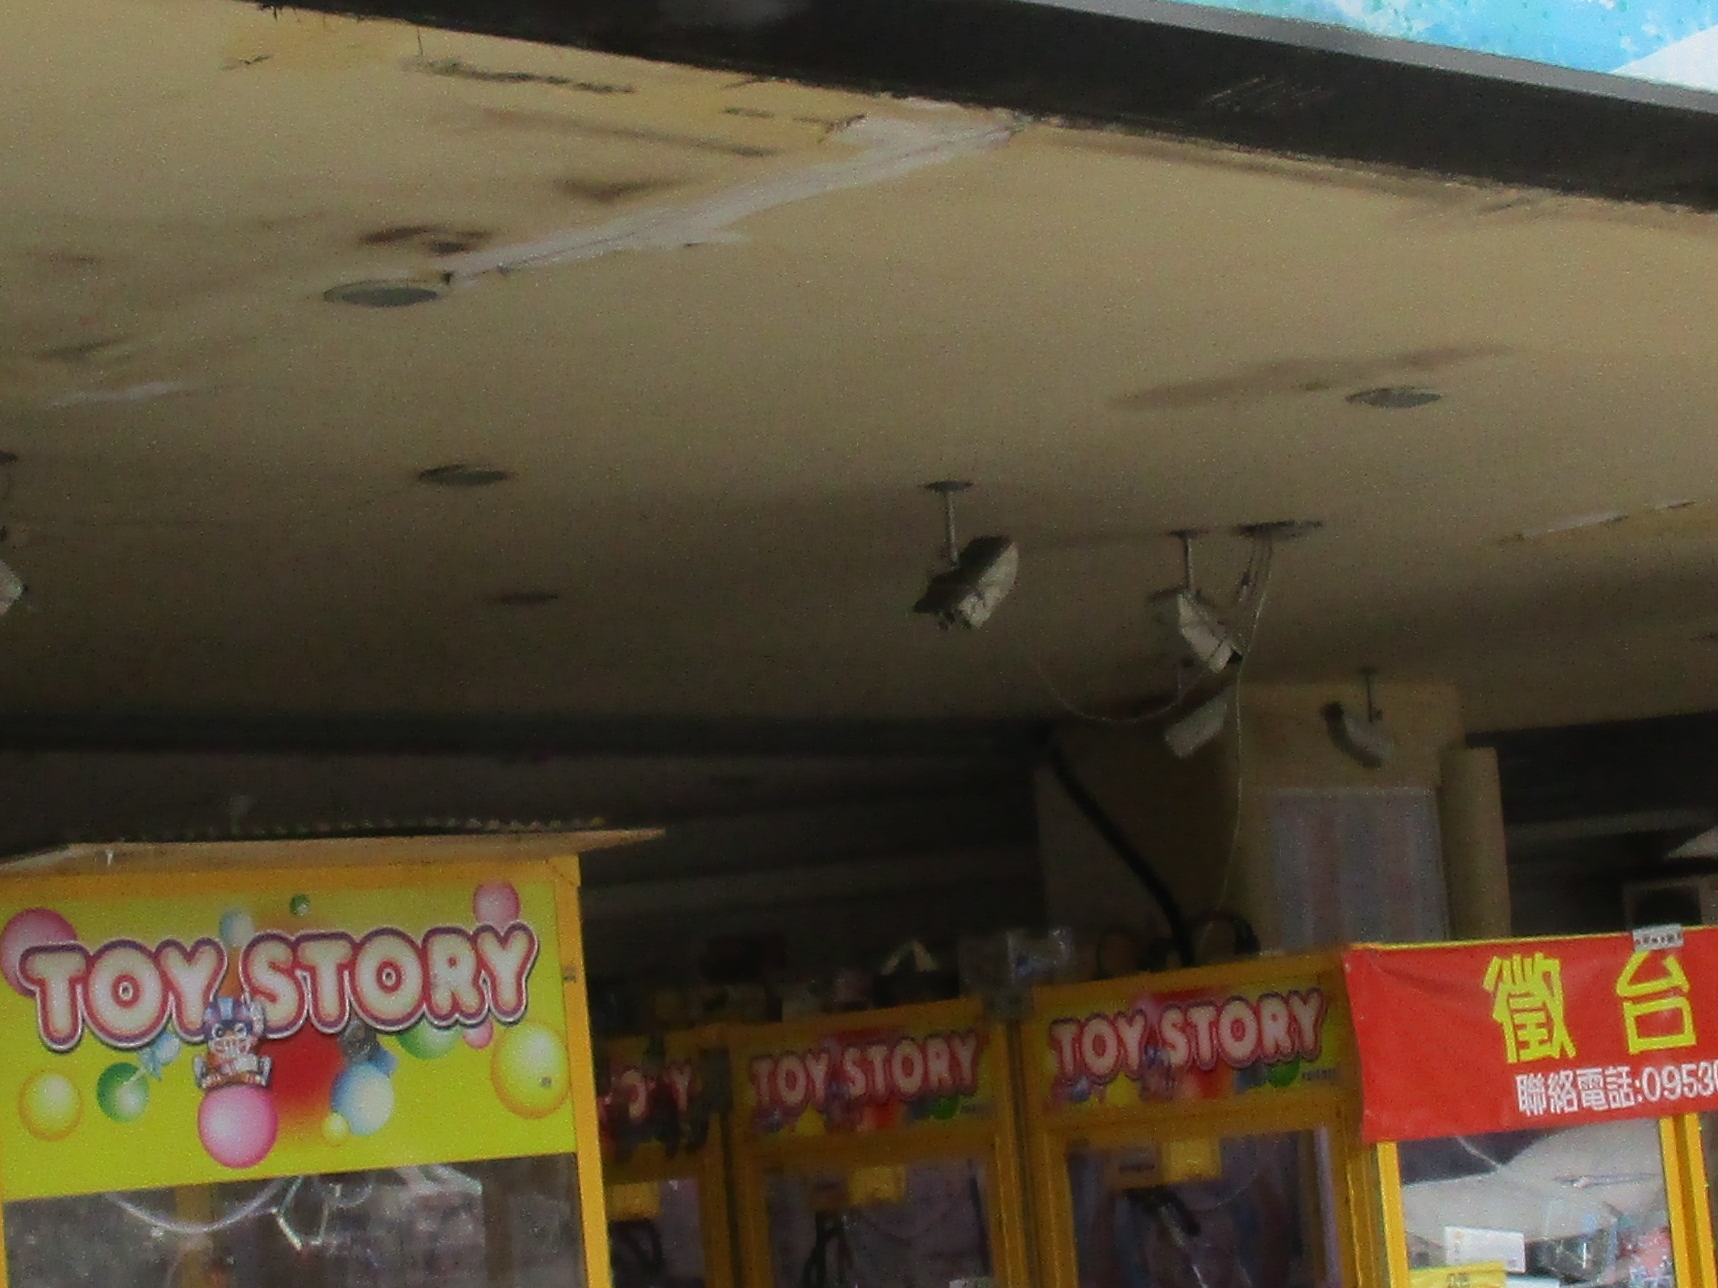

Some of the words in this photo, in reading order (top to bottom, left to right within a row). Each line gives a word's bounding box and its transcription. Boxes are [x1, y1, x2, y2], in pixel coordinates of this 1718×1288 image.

[18, 935, 228, 1050] TOY
[240, 919, 539, 1040] STORY
[749, 1048, 832, 1112] TOY
[840, 1030, 985, 1104] STORY
[1048, 1009, 1148, 1084] TOY
[1157, 987, 1327, 1071] STORY
